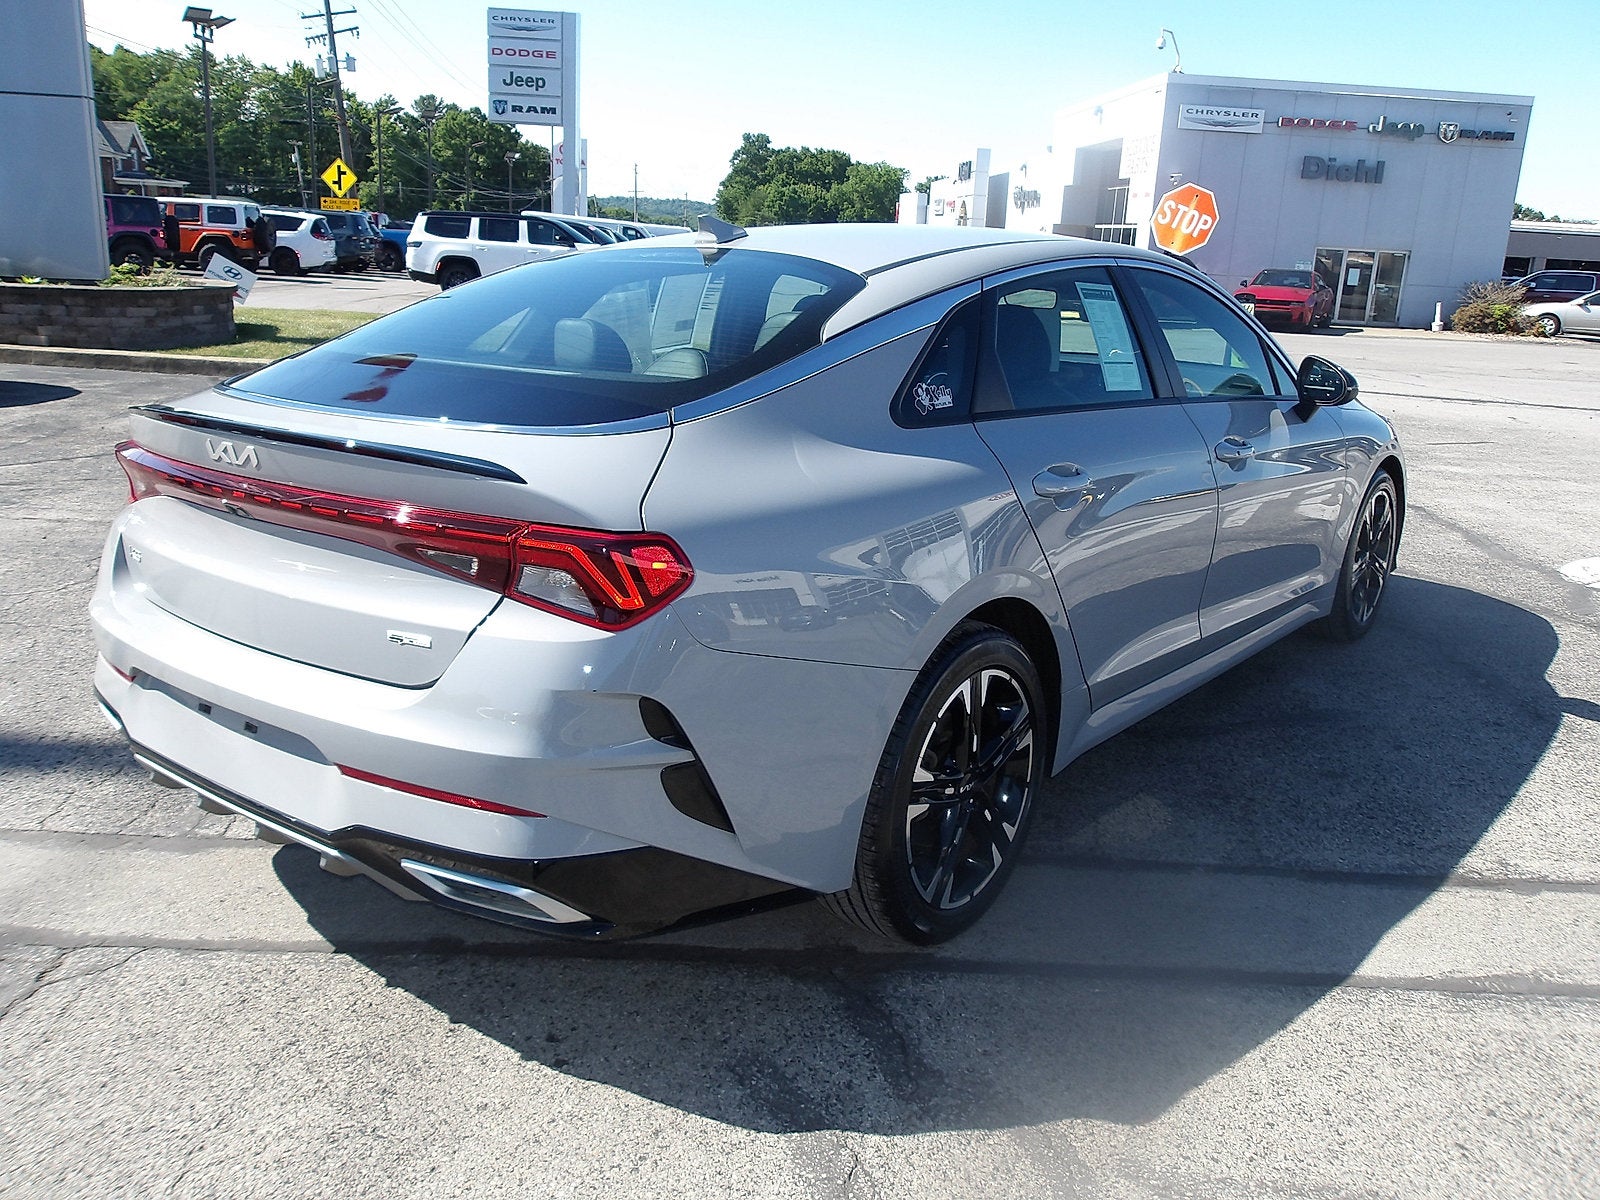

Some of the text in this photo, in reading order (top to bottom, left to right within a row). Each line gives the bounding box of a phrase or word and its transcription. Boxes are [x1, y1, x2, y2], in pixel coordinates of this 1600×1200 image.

[492, 15, 555, 24] CHRYSLER
[491, 47, 557, 59] DODGE
[502, 71, 546, 91] Jeep
[511, 104, 557, 115] RAM
[1186, 108, 1259, 119] CHRYSLER
[1277, 116, 1358, 131] DODGE
[1368, 115, 1425, 141] Jeep
[1301, 155, 1386, 184] Diehl
[1157, 200, 1213, 238] STOP
[206, 438, 260, 468] KIA
